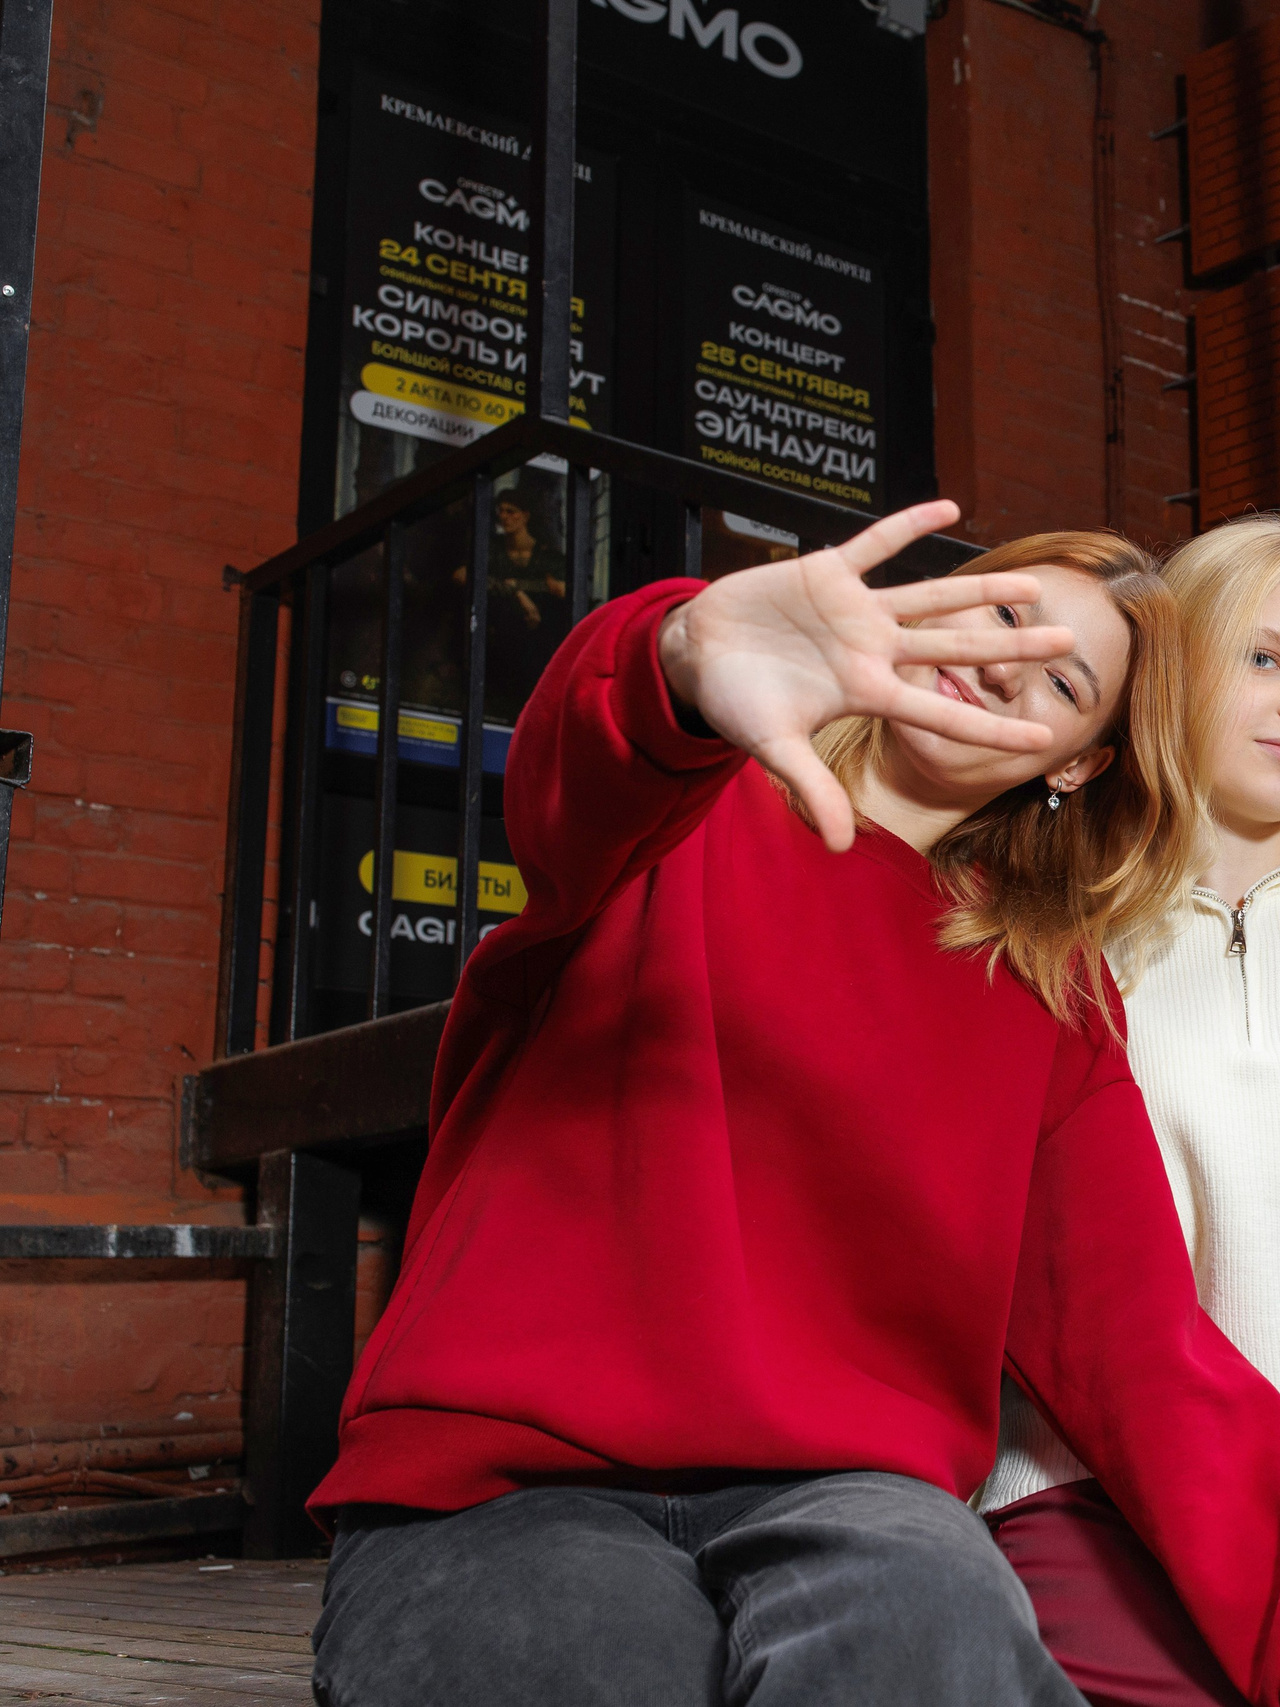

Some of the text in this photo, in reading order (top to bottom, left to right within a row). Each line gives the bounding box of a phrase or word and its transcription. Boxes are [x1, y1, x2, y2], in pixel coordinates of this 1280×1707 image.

[588, 0, 803, 79] GMO
[380, 94, 519, 157] КРЕМЛЕВСКИЙ
[418, 178, 530, 232] CAGM
[378, 238, 421, 267] 24
[413, 221, 529, 275] КОНЦЕР
[699, 209, 871, 283] КРЕМЛЕВСКИЙ ДВОРЕЦ
[731, 284, 842, 336] CAGMO
[351, 304, 499, 366] КОРОЛЬ
[503, 347, 527, 374] И
[371, 339, 513, 393] БОЛЬШОЙ СОСТАВ
[729, 320, 845, 373] КОНЦЕРТ
[395, 377, 406, 392] 2
[409, 380, 452, 404] АКТА
[455, 395, 482, 413] ПО
[484, 403, 505, 419] 60
[701, 340, 737, 367] 25
[739, 353, 871, 409] СЕНТЯБРЯ
[371, 401, 475, 440] ДЕКОРАЦИИ
[694, 379, 877, 450] САУНДТРЕКИ
[694, 409, 877, 484] ЭЙНАУДИ
[700, 445, 872, 505] ТРОЙНОЙ СОСТАВ ОРКЕСТРА
[424, 869, 512, 897] БИТЫ
